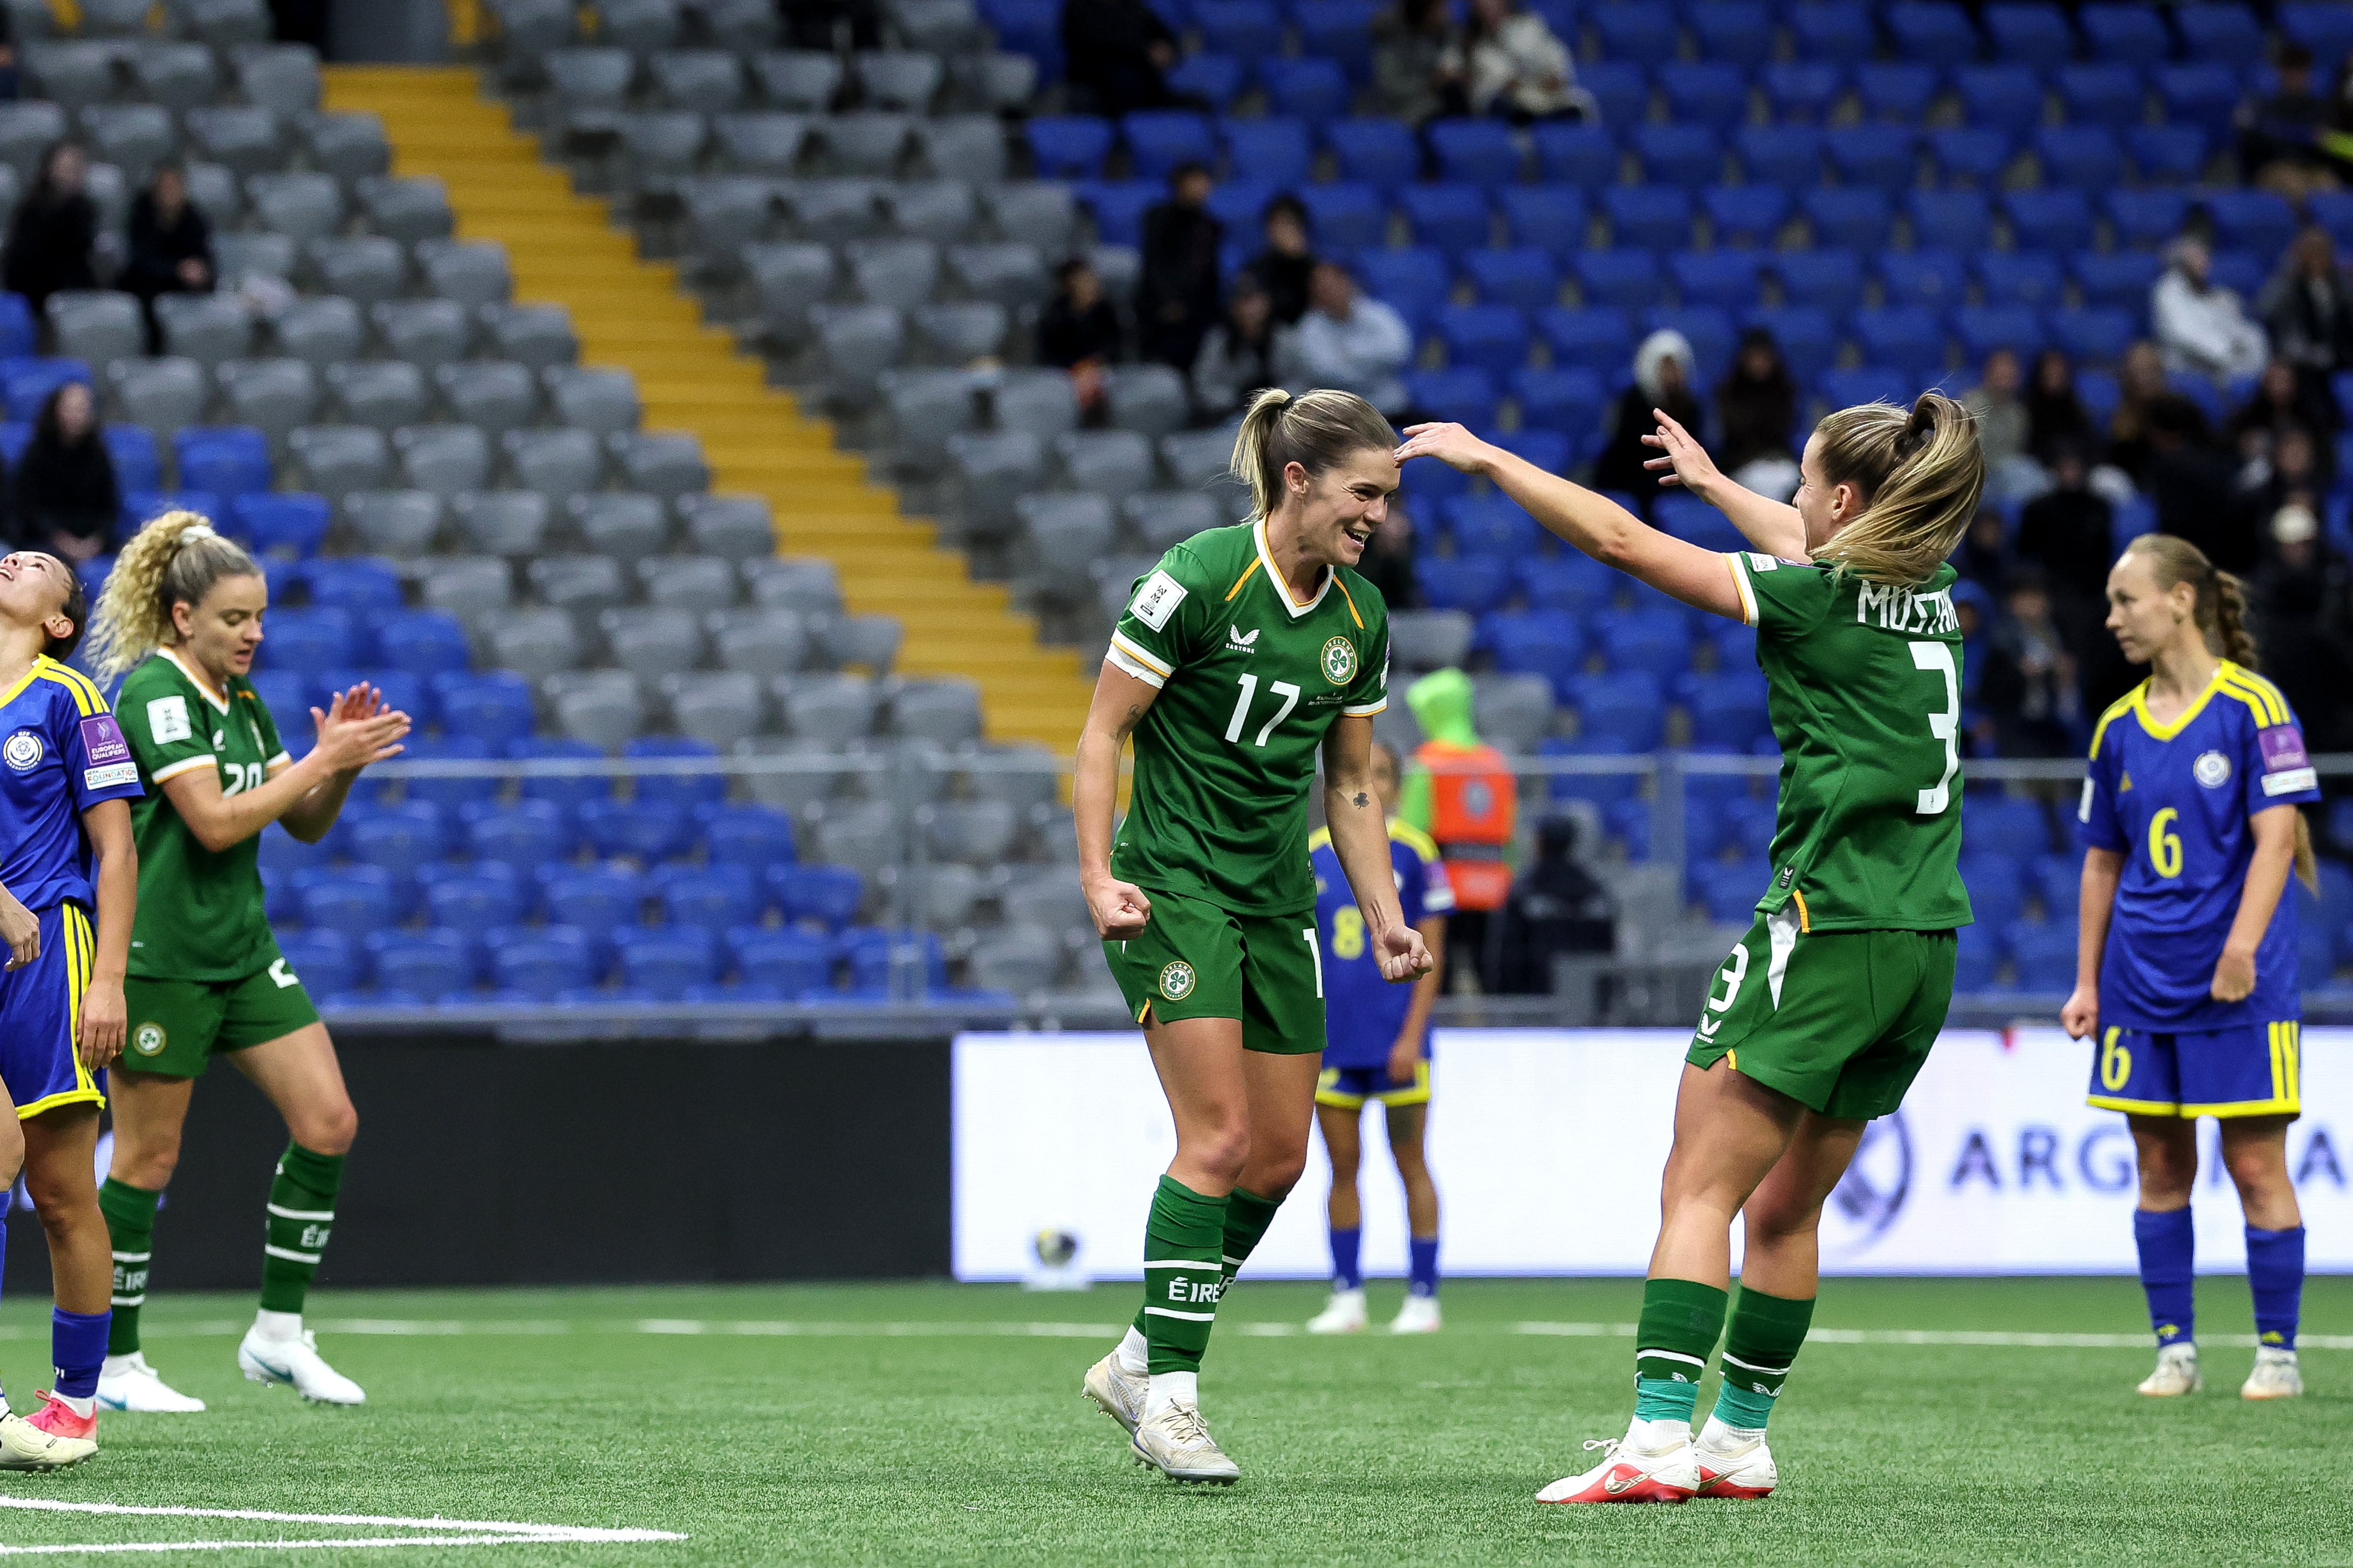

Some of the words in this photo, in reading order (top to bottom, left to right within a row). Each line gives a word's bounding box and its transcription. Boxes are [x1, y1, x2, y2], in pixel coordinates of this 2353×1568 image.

[1325, 639, 1354, 657] IRELAND
[1225, 673, 1301, 747] 17
[1908, 641, 1959, 814] 3
[87, 769, 136, 782] FOUNDATION
[91, 743, 124, 754] EUROPEAN
[92, 748, 126, 760] QUALIFIERS
[2148, 807, 2184, 879] 6
[1332, 906, 1364, 960] 8
[1709, 942, 1749, 1013] 3
[2100, 1025, 2132, 1092] 6
[1168, 1276, 1220, 1303] ÉIRE
